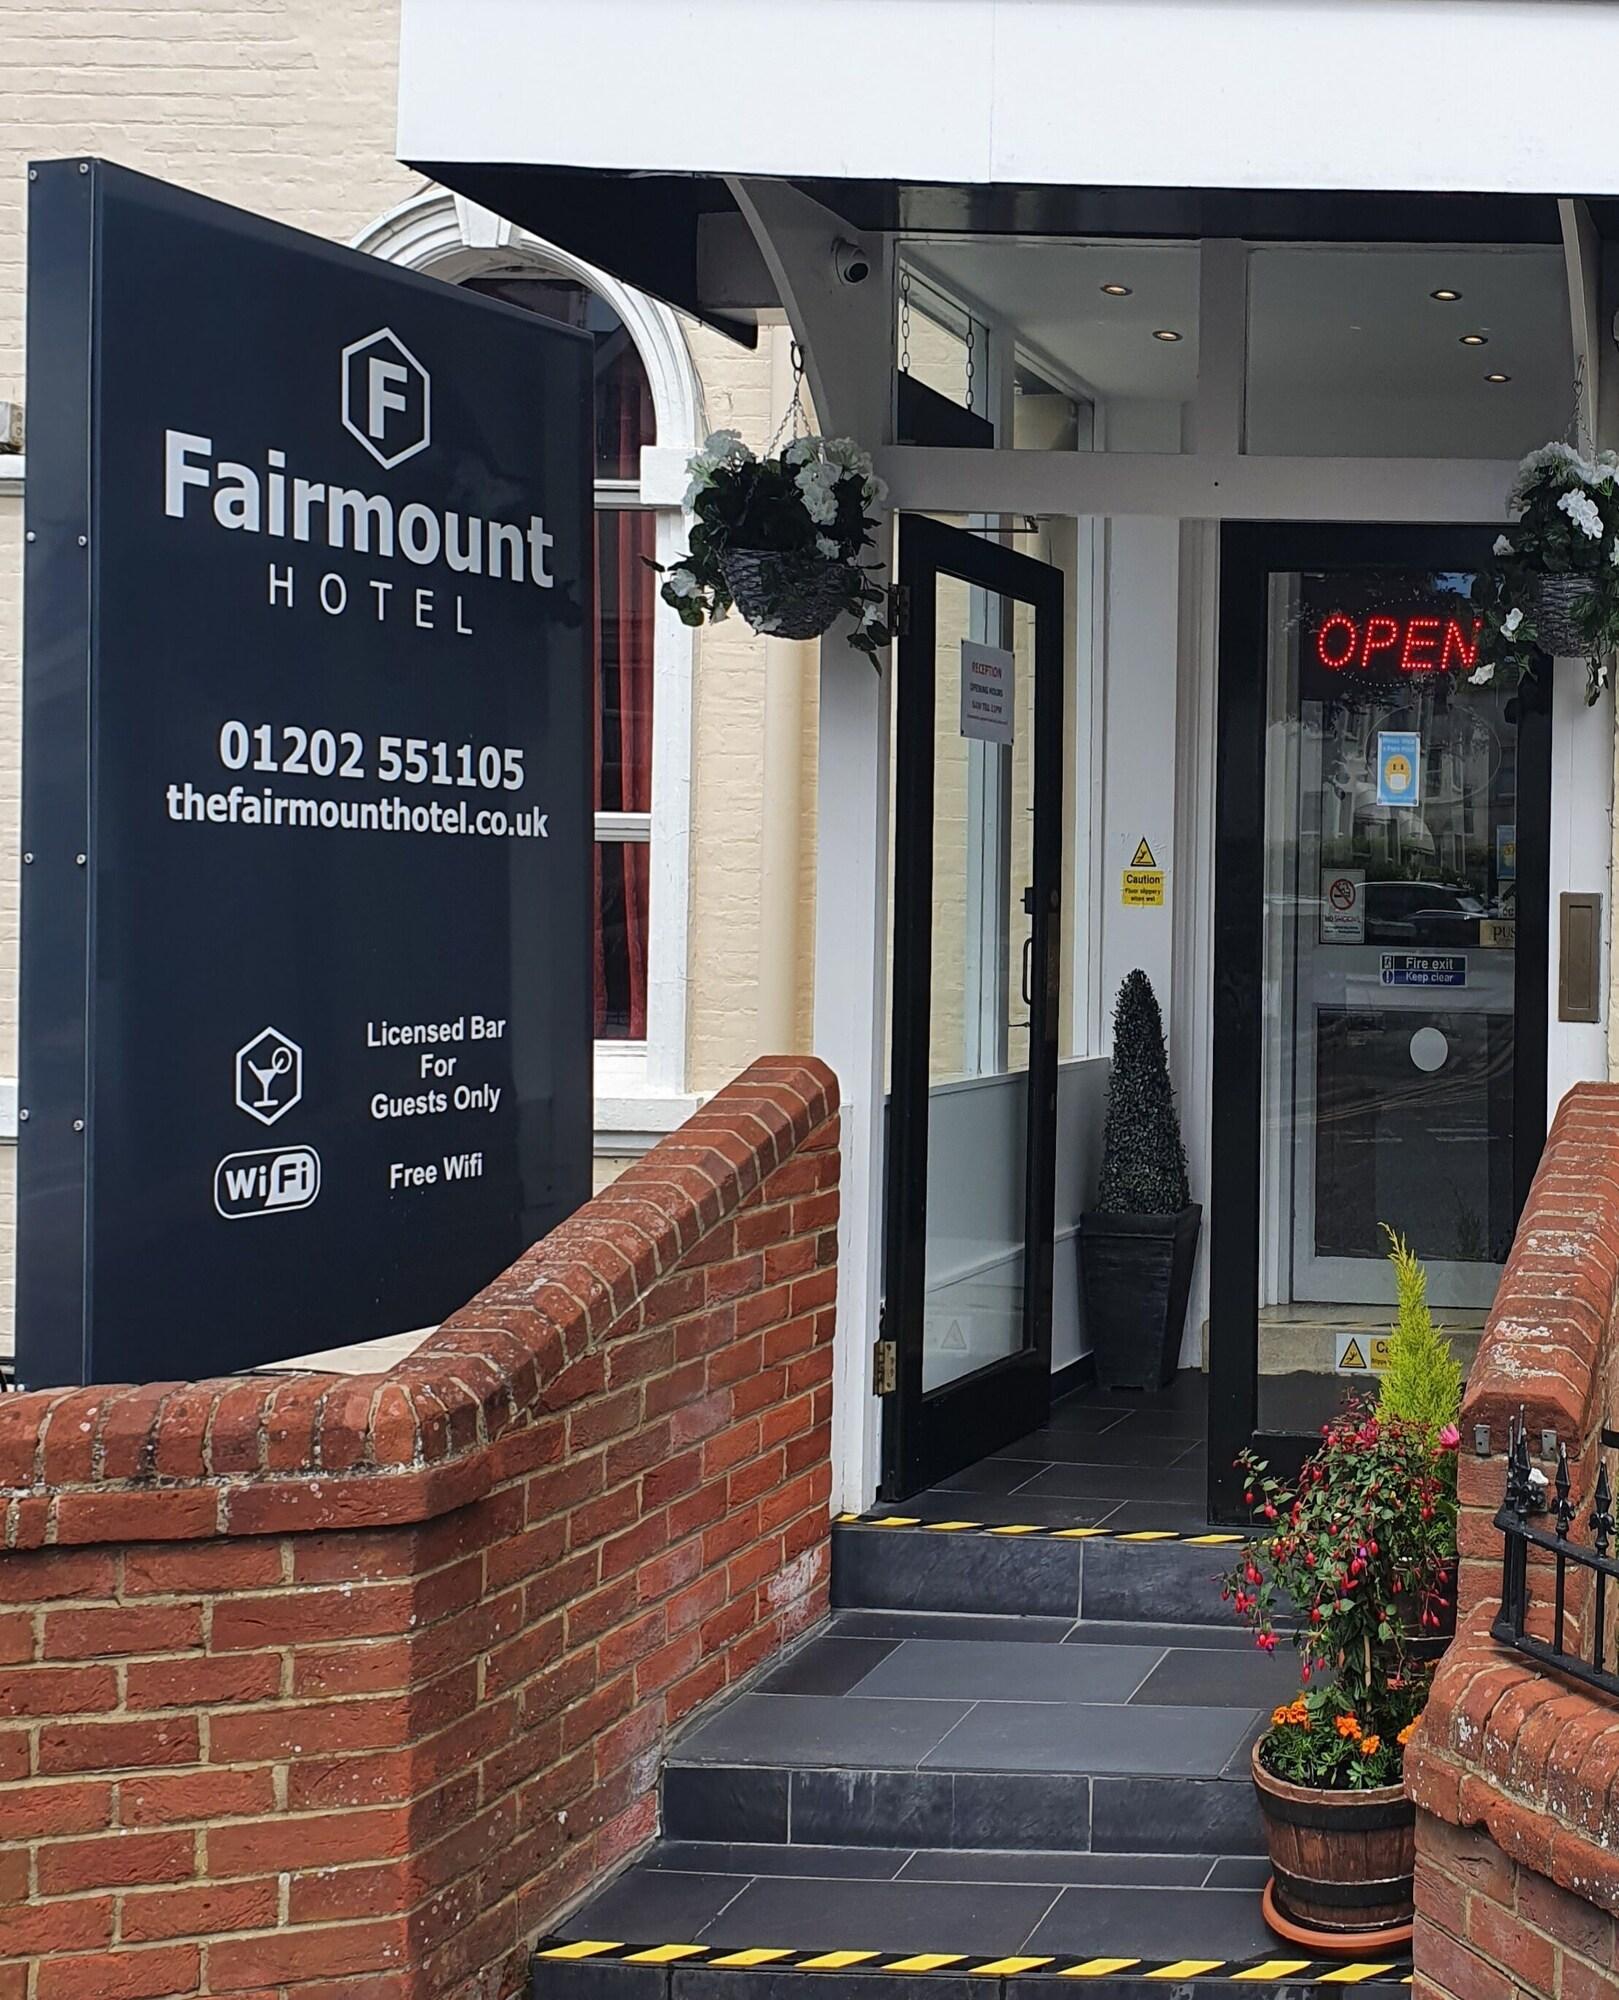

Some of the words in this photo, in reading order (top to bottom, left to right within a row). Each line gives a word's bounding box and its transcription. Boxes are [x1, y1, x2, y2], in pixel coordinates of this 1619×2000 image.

[369, 356, 408, 440] F
[165, 428, 554, 588] Fairmount
[269, 563, 473, 635] HOTEL
[1317, 617, 1482, 669] OPEN
[972, 661, 1002, 679] RECEPTION
[218, 720, 364, 778] 01202
[377, 736, 525, 790] 551105
[166, 783, 549, 837] thefairmounthotel.co.uk
[1126, 874, 1160, 884] Caution
[1493, 926, 1515, 942] PUS
[1406, 957, 1429, 969] Fire
[1432, 958, 1454, 970] exit
[1406, 971, 1428, 983] Keep
[1431, 973, 1454, 982] clear
[367, 1018, 465, 1047] Licensed
[470, 1016, 506, 1040] Bar
[420, 1054, 457, 1079] For
[371, 1090, 447, 1119] Guests
[453, 1084, 501, 1113] Only
[389, 1162, 437, 1189] Free
[443, 1152, 483, 1180] Wifi
